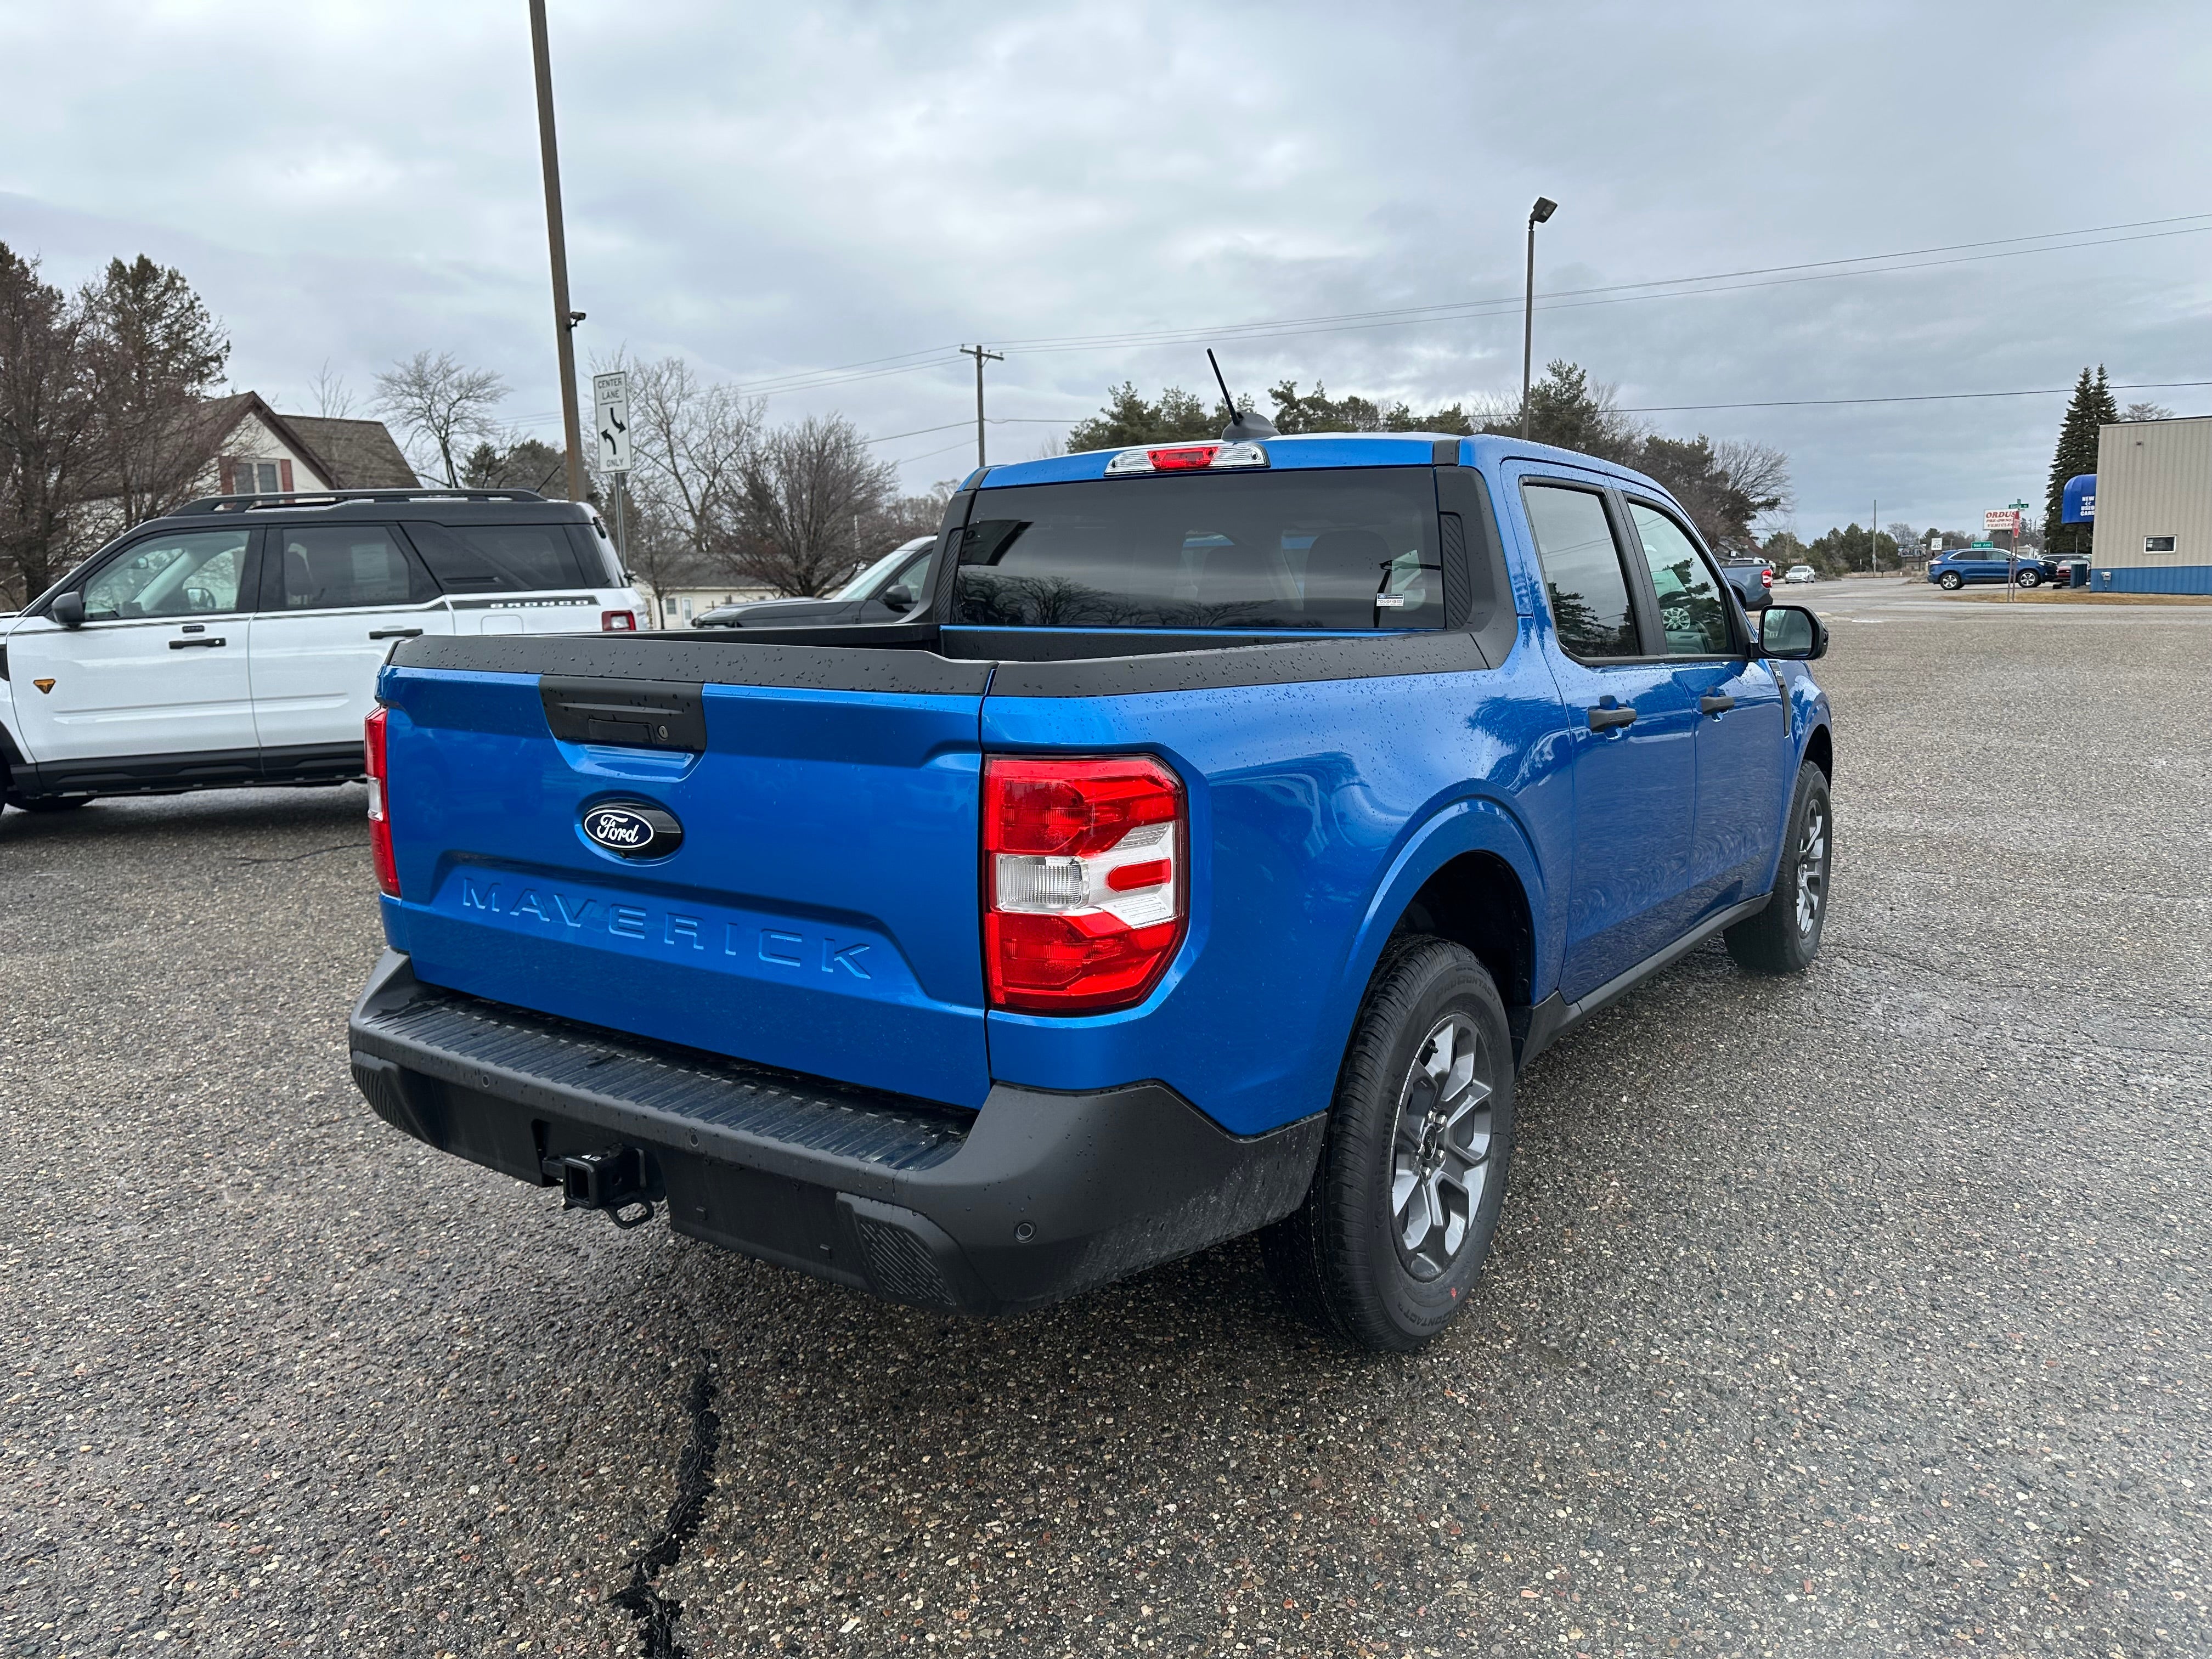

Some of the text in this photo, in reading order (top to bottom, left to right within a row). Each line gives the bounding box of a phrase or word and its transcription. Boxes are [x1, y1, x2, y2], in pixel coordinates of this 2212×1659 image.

[597, 377, 623, 389] CENTER
[602, 390, 620, 400] LANE
[606, 458, 624, 467] ONLY
[597, 814, 639, 843] Ford
[462, 878, 871, 980] MAVERICK
